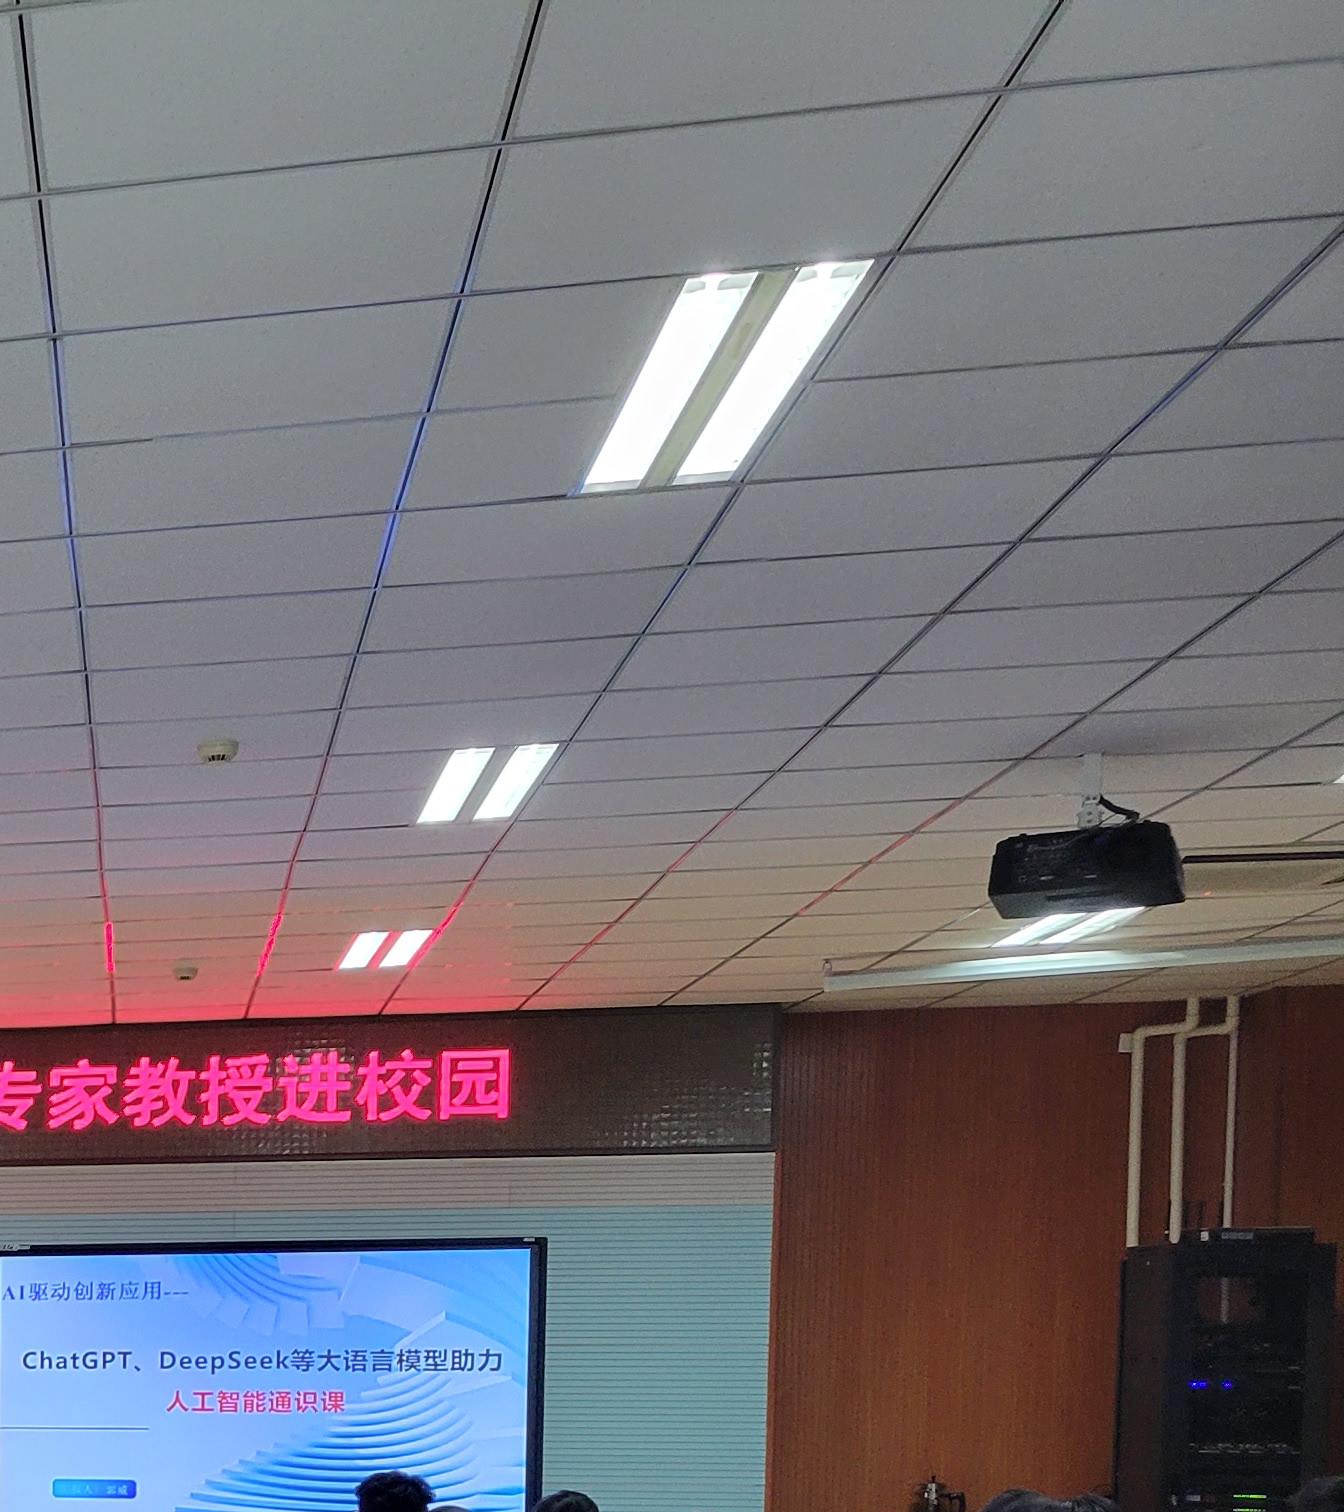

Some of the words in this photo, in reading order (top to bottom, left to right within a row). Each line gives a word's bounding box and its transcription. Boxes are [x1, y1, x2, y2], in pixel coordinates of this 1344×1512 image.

[166, 1390, 346, 1414] 人工智能通识课
